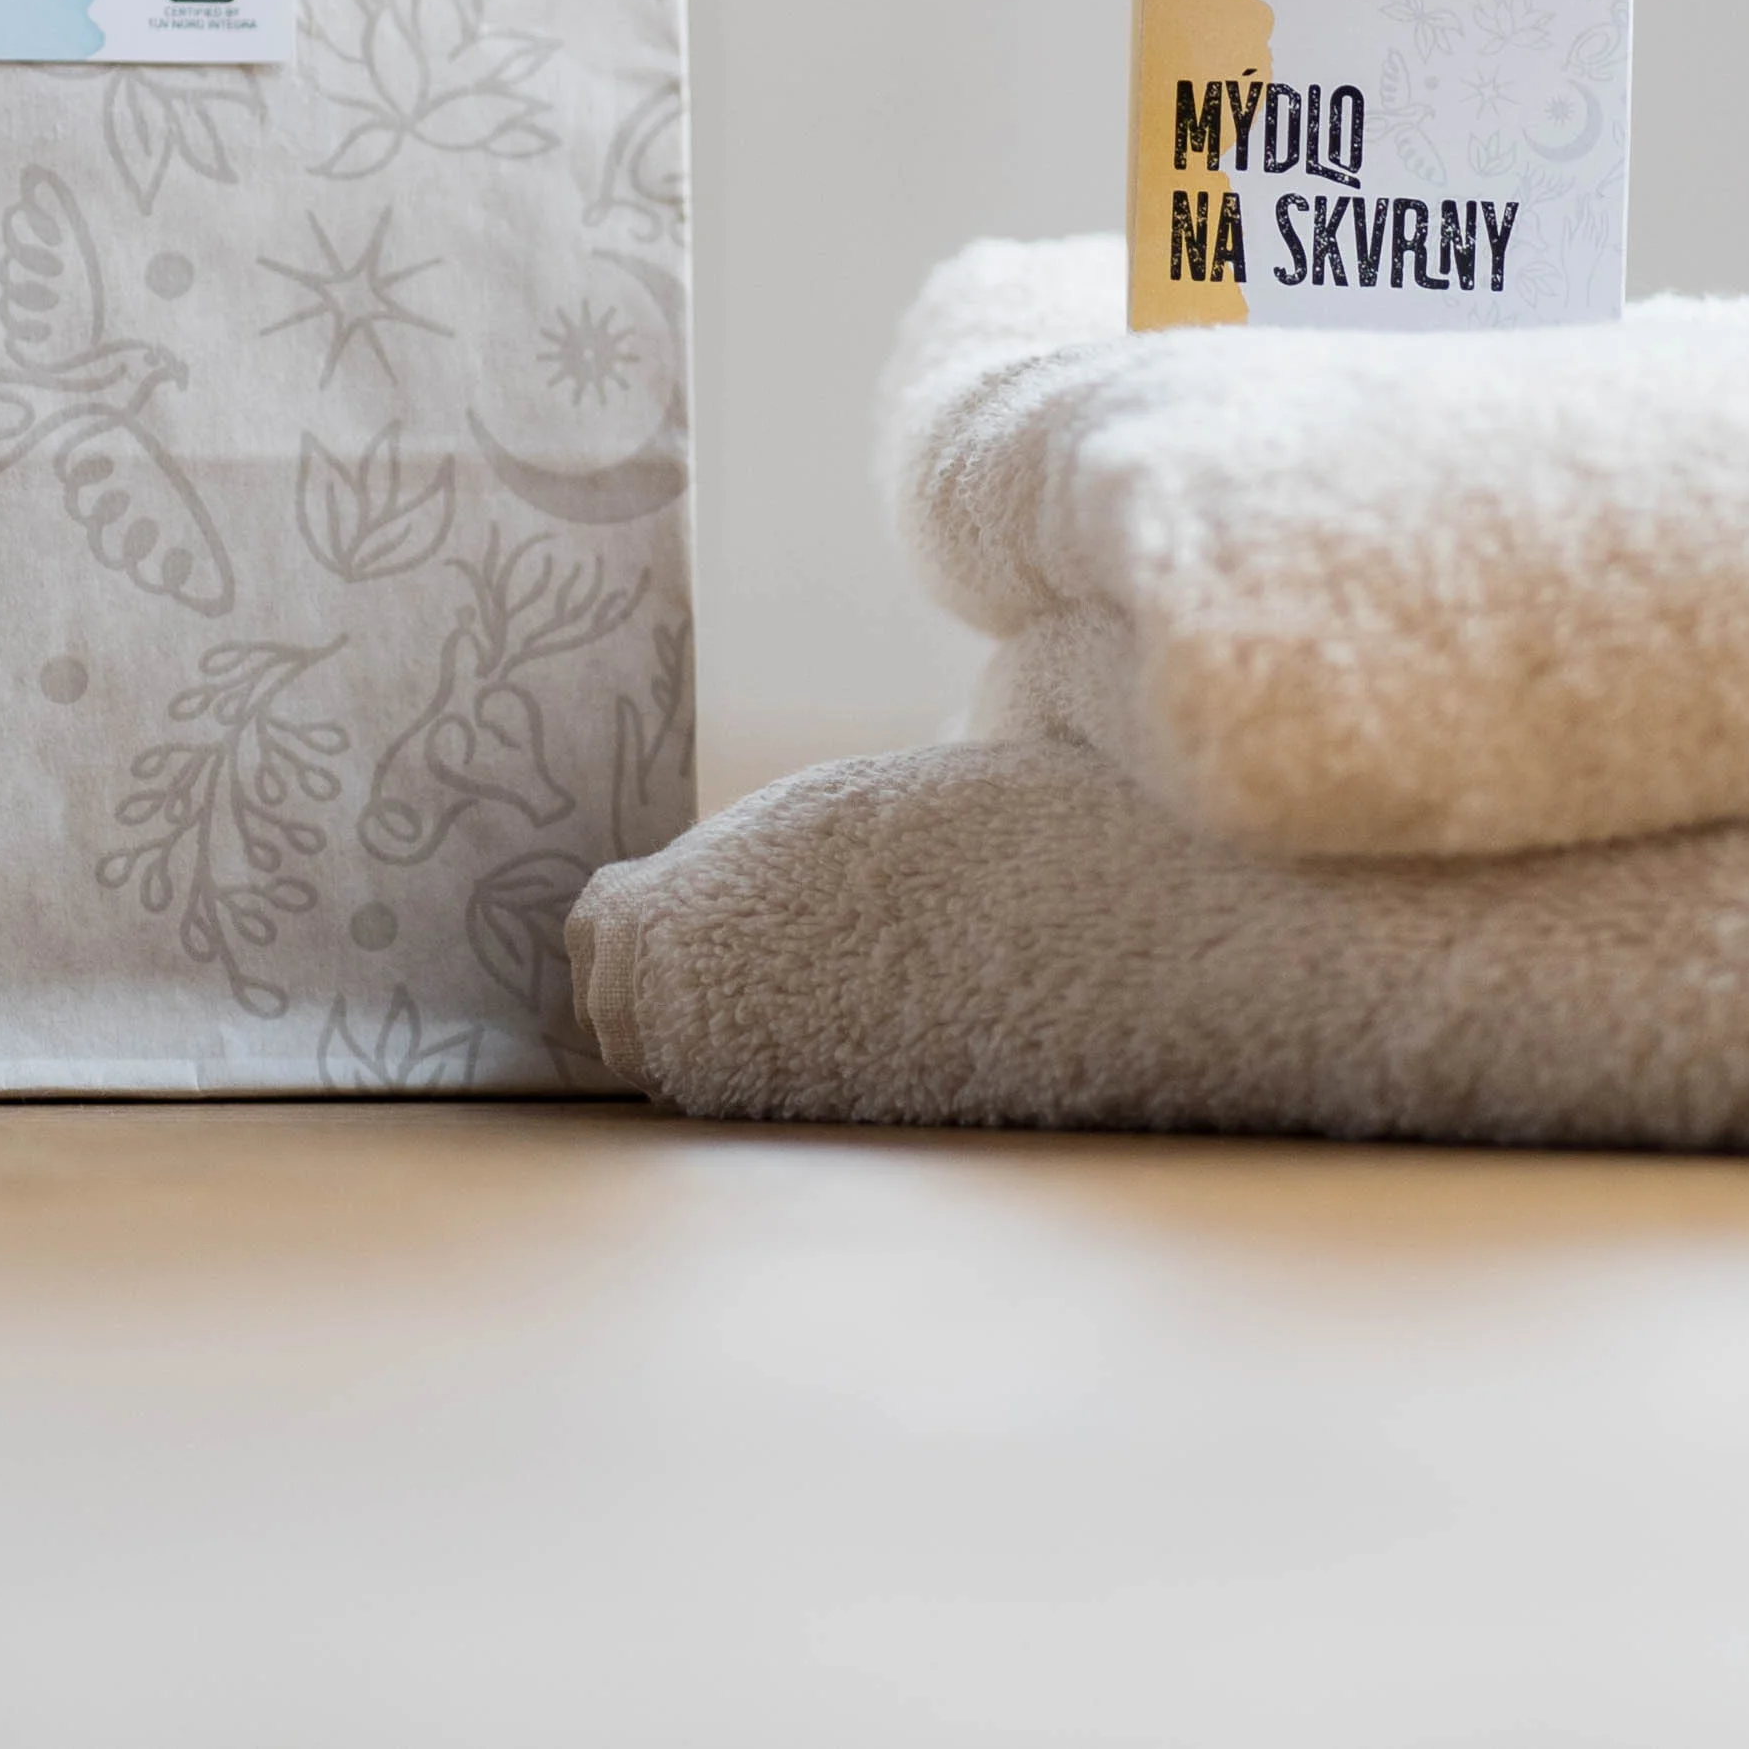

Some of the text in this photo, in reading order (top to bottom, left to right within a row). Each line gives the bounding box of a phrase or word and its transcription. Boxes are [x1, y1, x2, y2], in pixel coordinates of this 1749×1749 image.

[1173, 68, 1365, 188] MÝDLO
[1170, 191, 1519, 292] NA SKVRNY
